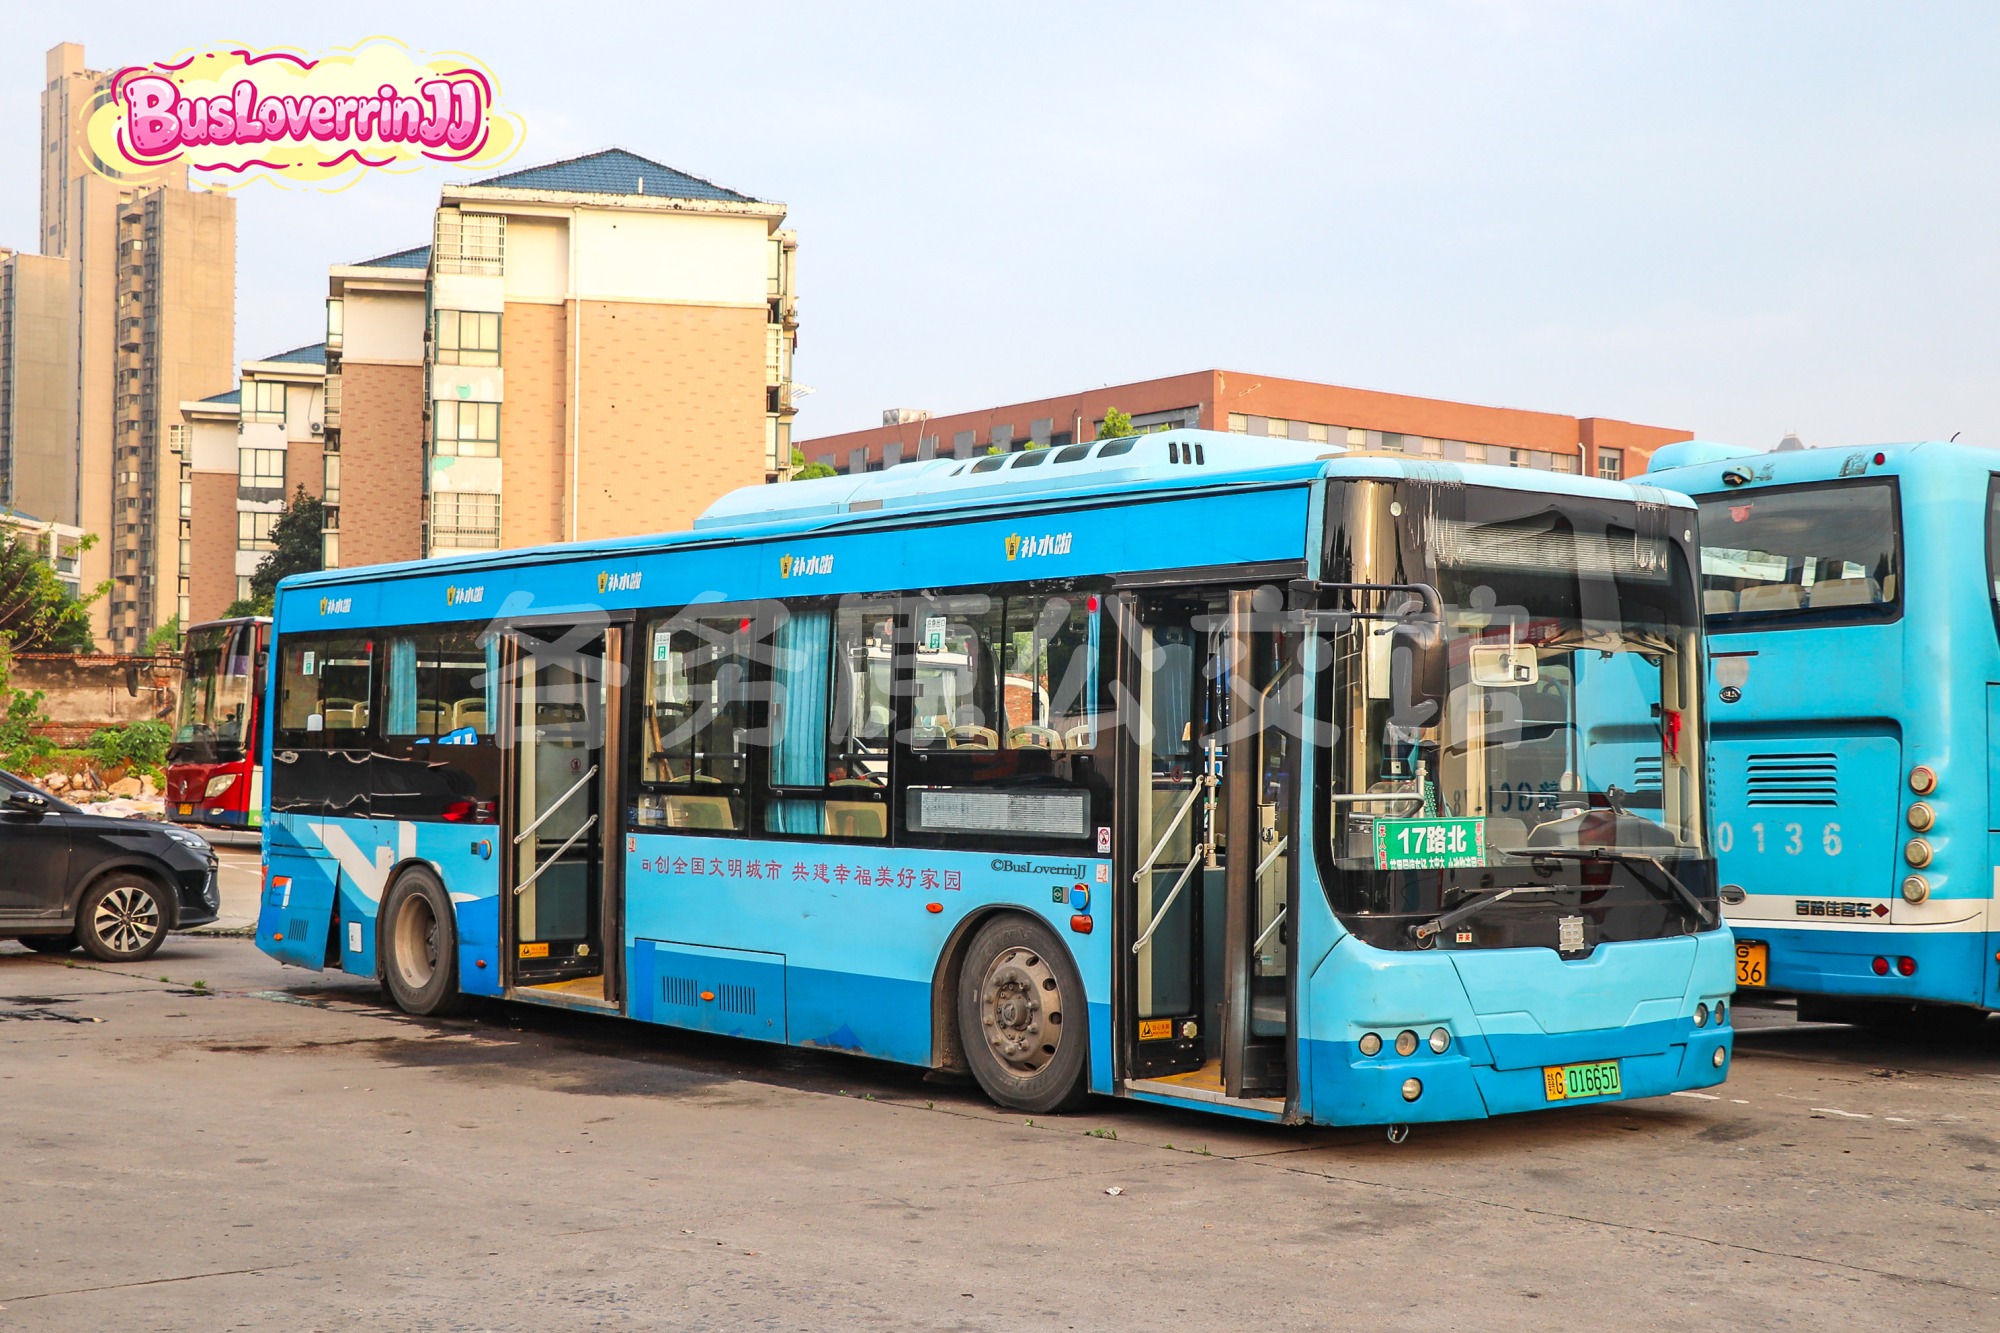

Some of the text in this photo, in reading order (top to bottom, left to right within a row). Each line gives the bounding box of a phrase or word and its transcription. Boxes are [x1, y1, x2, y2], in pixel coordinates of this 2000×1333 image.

[1021, 532, 1073, 558] 补水啦
[793, 554, 834, 577] 补水啦
[608, 571, 643, 591] 补水啦
[1397, 825, 1467, 854] 17路北
[1717, 821, 1843, 856] 0136
[791, 861, 962, 891] 共建幸福美好家园
[1795, 900, 1872, 918] 百路佳客车
